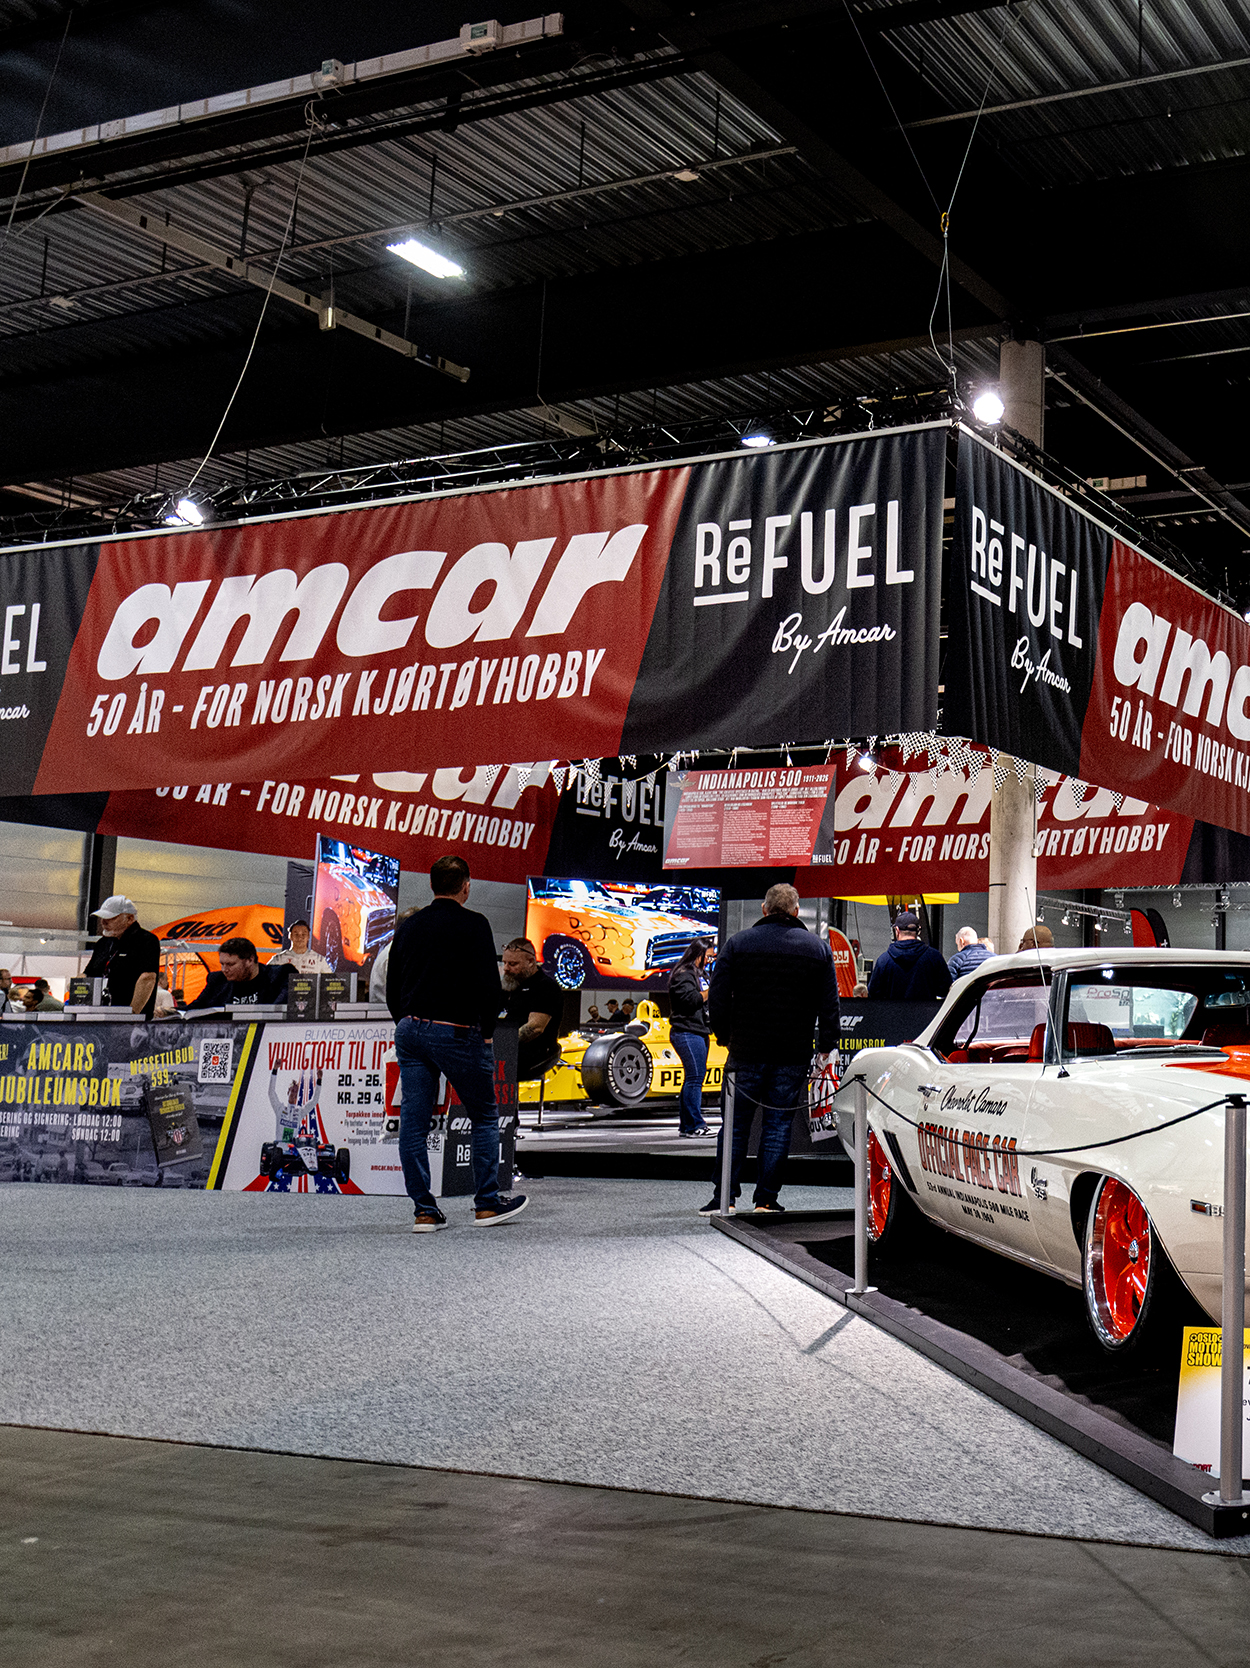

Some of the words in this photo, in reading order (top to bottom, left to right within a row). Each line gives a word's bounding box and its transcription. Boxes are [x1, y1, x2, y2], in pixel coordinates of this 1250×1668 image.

[97, 524, 648, 680] amcar
[772, 606, 814, 673] By
[814, 606, 896, 653] Amcar
[1011, 636, 1034, 694] By
[1033, 649, 1071, 694] Amcar
[86, 692, 125, 737] 50
[127, 682, 163, 735] ÅR
[190, 683, 246, 729] FOR
[250, 672, 351, 726] NORSK
[352, 648, 606, 717] KJØRTØYHOBBY
[1110, 696, 1131, 742] 50
[1132, 699, 1153, 751] ÅR
[1164, 721, 1192, 767] FOR
[1195, 733, 1235, 783] NORSK
[698, 772, 776, 790] INDIANAPOLIS
[779, 770, 802, 787] 500
[256, 780, 305, 817] FOR
[308, 789, 383, 829] NORSK
[384, 800, 534, 850] KJØRTØYHOBBY
[609, 828, 625, 860] By
[626, 831, 658, 853] Amcar
[853, 834, 878, 864] ÅR
[899, 835, 935, 862] FOR
[939, 832, 991, 860] NORS
[1036, 823, 1170, 858] ØRTØYHOBBY
[305, 1029, 320, 1040] BLI
[322, 1029, 346, 1040] MED
[347, 1028, 388, 1040] AMCAR
[27, 1042, 95, 1071] AMCARS
[130, 1046, 198, 1075] MESSETILBUD:
[348, 1041, 367, 1070] TIL
[338, 1074, 355, 1086] 20.
[365, 1074, 382, 1086] 26.
[337, 1092, 354, 1104] KR.
[357, 1092, 371, 1104] 29
[23, 1113, 33, 1125] OG
[73, 1115, 100, 1127] LØRDAG
[102, 1115, 122, 1127] 12:00
[72, 1128, 99, 1141] SØNDAG
[100, 1129, 120, 1141] 12:00
[963, 1130, 994, 1190] PACE
[993, 1134, 1022, 1198] CAR
[1000, 1204, 1014, 1217] MILE
[1014, 1209, 1030, 1222] RACE
[1197, 1333, 1218, 1342] OSLO
